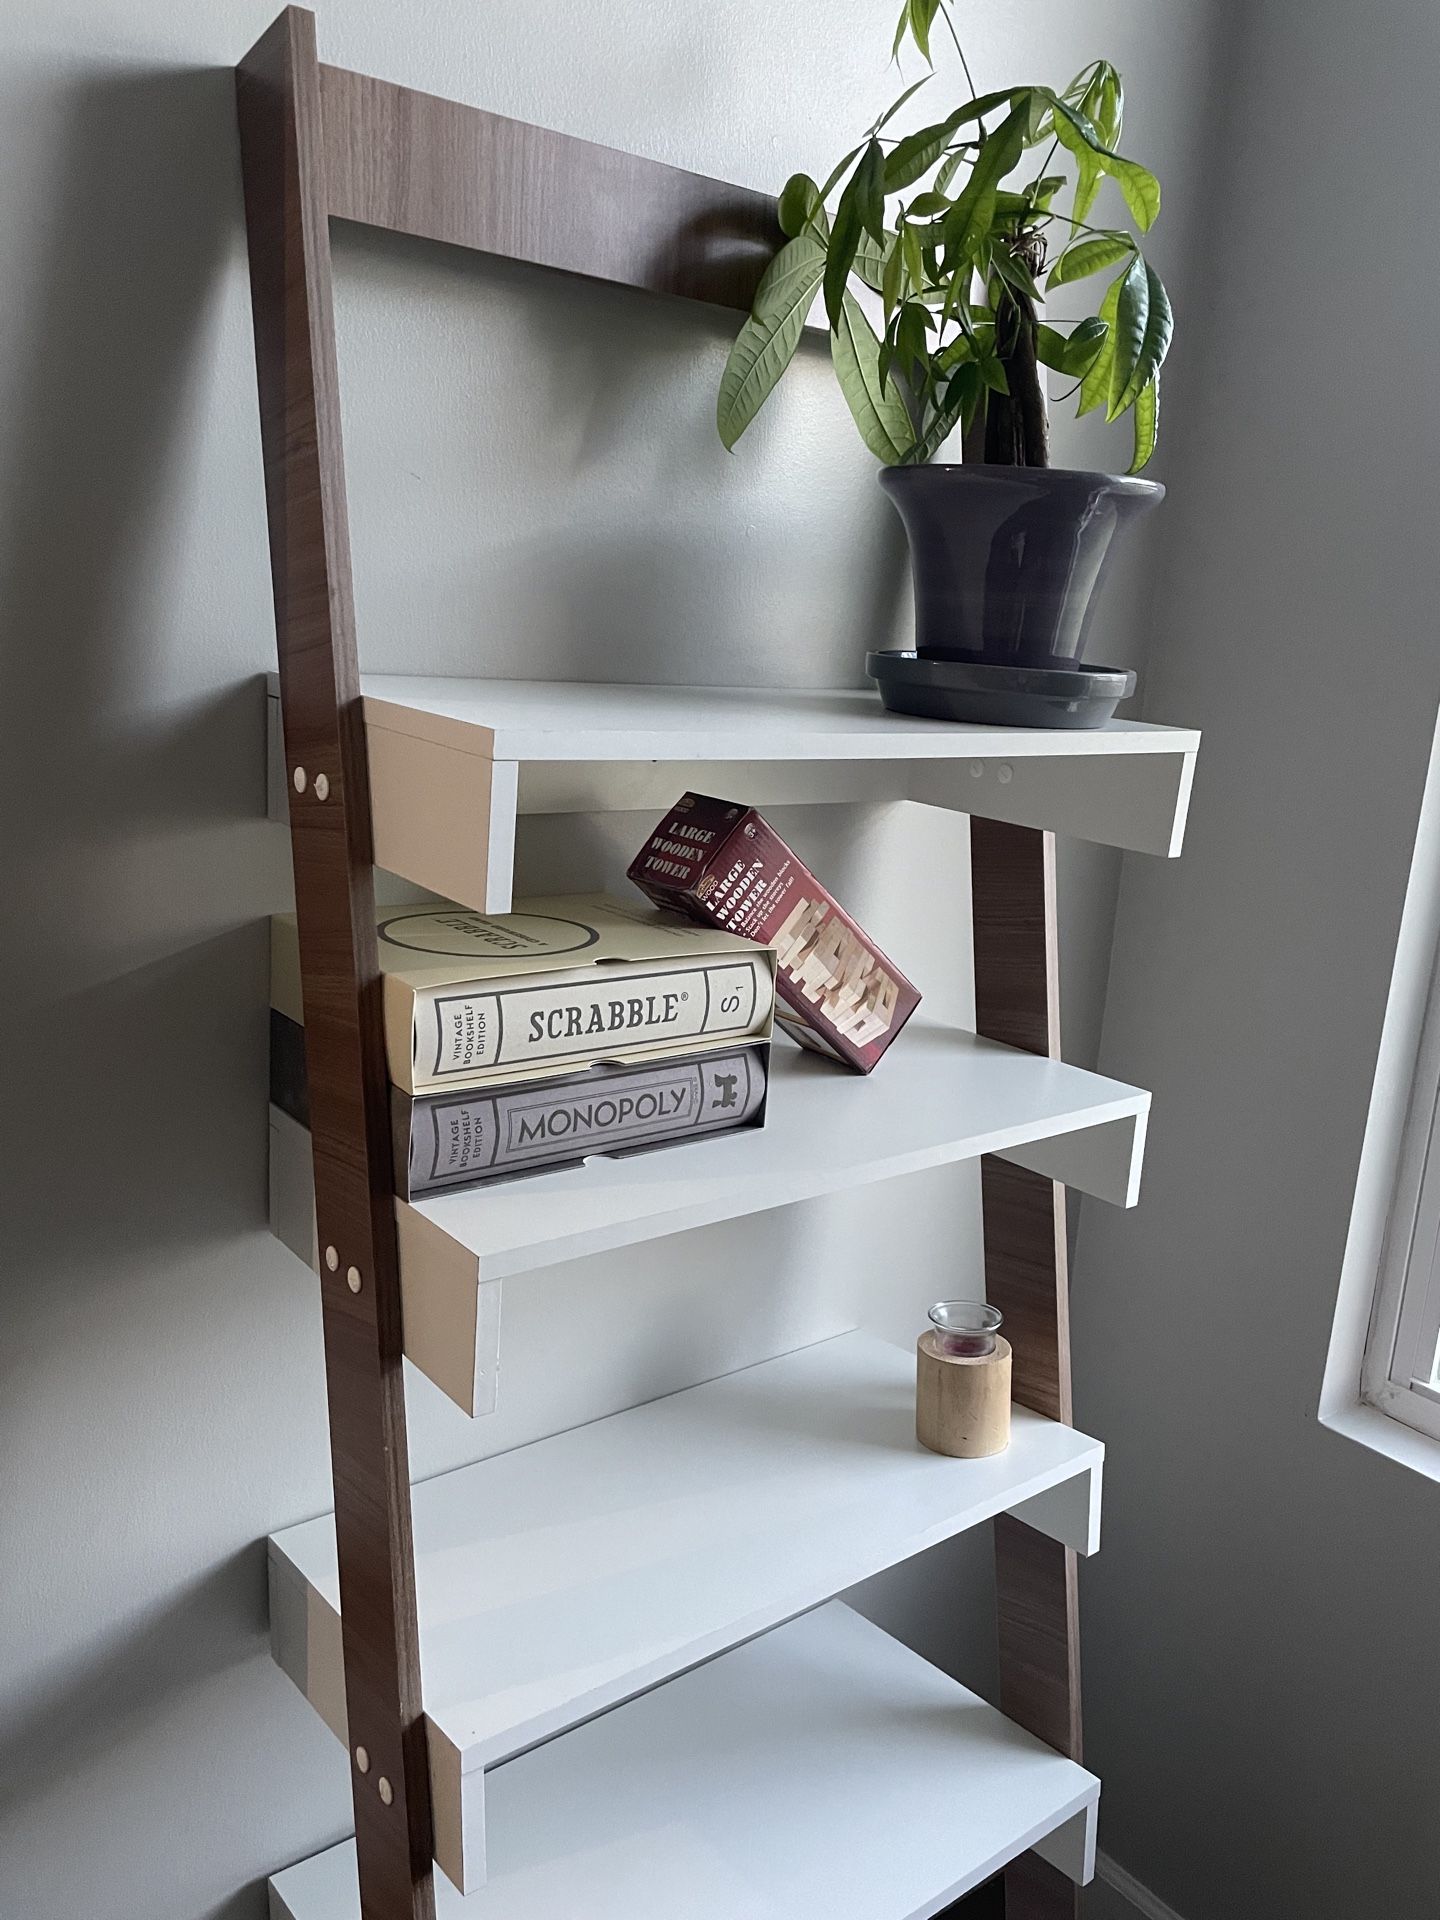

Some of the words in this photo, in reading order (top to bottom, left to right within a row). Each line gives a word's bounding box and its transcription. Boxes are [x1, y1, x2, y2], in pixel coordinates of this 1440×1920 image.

[651, 836, 706, 862] WOODEN
[668, 822, 716, 844] LARGE
[644, 855, 691, 879] TOWER
[705, 859, 746, 912] LARGE
[716, 858, 764, 920] WOODEN
[701, 880, 719, 901] WOOD
[726, 879, 768, 931] TOWER
[740, 907, 757, 928] Balance
[756, 898, 764, 908] the
[763, 876, 779, 898] wooden
[777, 860, 791, 877] blocks
[750, 921, 763, 937] Don't
[761, 913, 769, 921] let
[768, 903, 776, 914] the
[775, 888, 787, 904] tower
[745, 918, 758, 933] Stack
[756, 910, 764, 919] up
[762, 900, 770, 910] the
[452, 1014, 463, 1060] VINTAGE
[462, 1005, 475, 1065] BOOKSHELF
[476, 1012, 486, 1055] EDITION
[473, 1117, 483, 1158] EDITION
[518, 1087, 687, 1143] MONOPOLY
[448, 1119, 460, 1165] VINTAGE
[459, 1109, 472, 1168] BOOKSHELF
